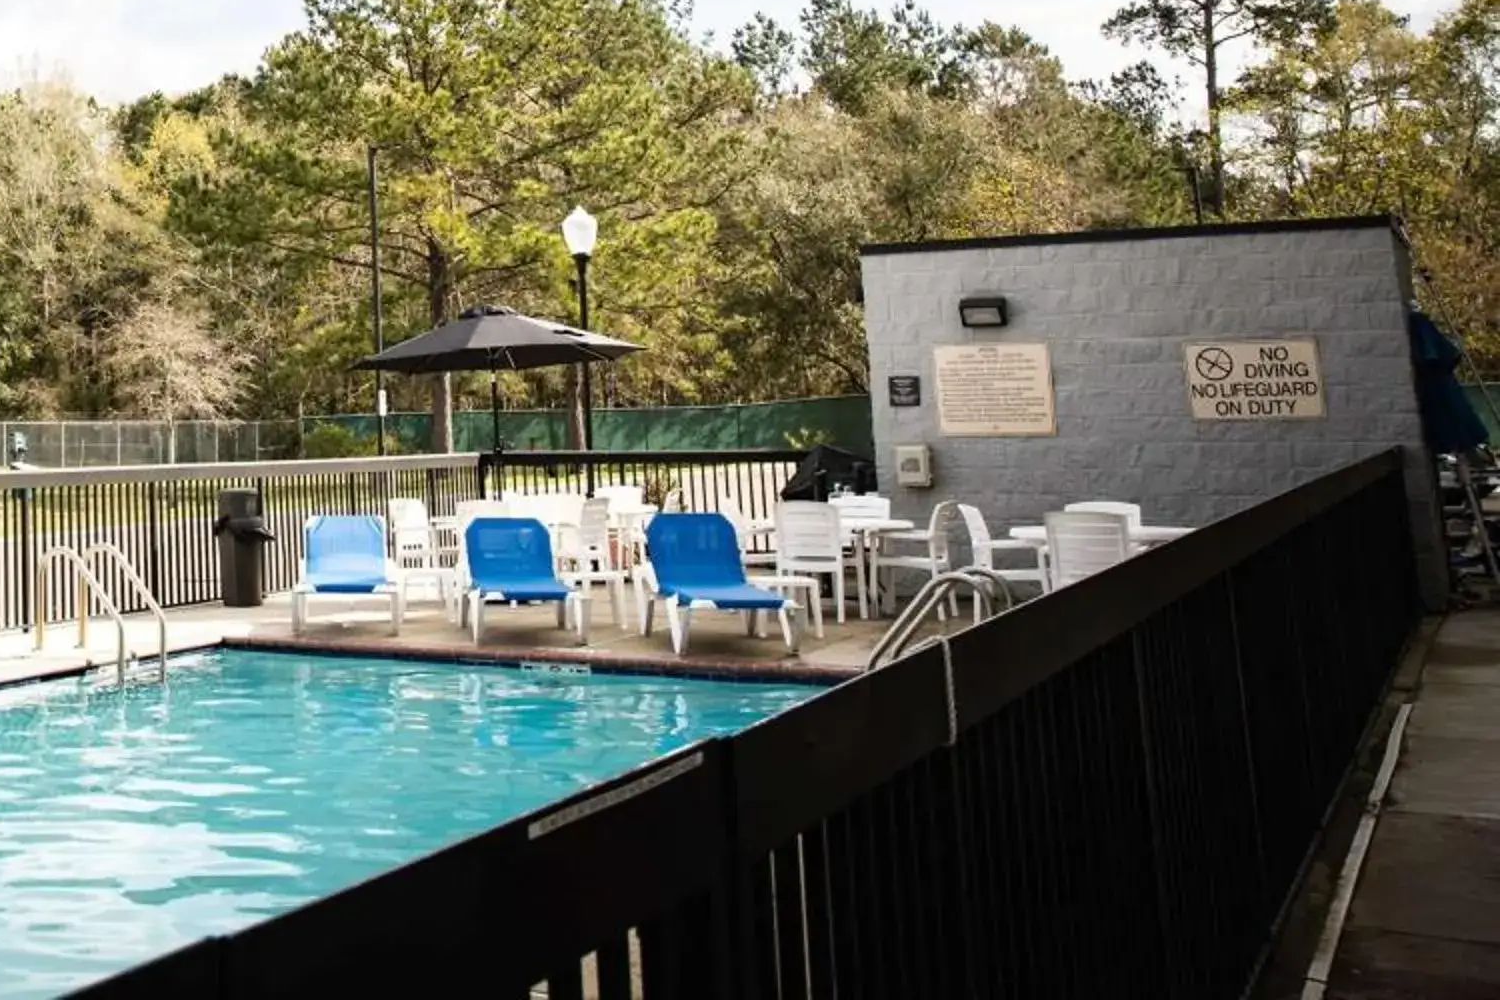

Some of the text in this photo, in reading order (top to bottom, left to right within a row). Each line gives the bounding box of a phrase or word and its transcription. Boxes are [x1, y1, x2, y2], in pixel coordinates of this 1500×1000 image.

[1259, 346, 1289, 361] NO
[1244, 361, 1309, 379] DIVING
[1191, 381, 1318, 399] NO LIFEGUARD
[1215, 399, 1297, 416] ON DUTY
